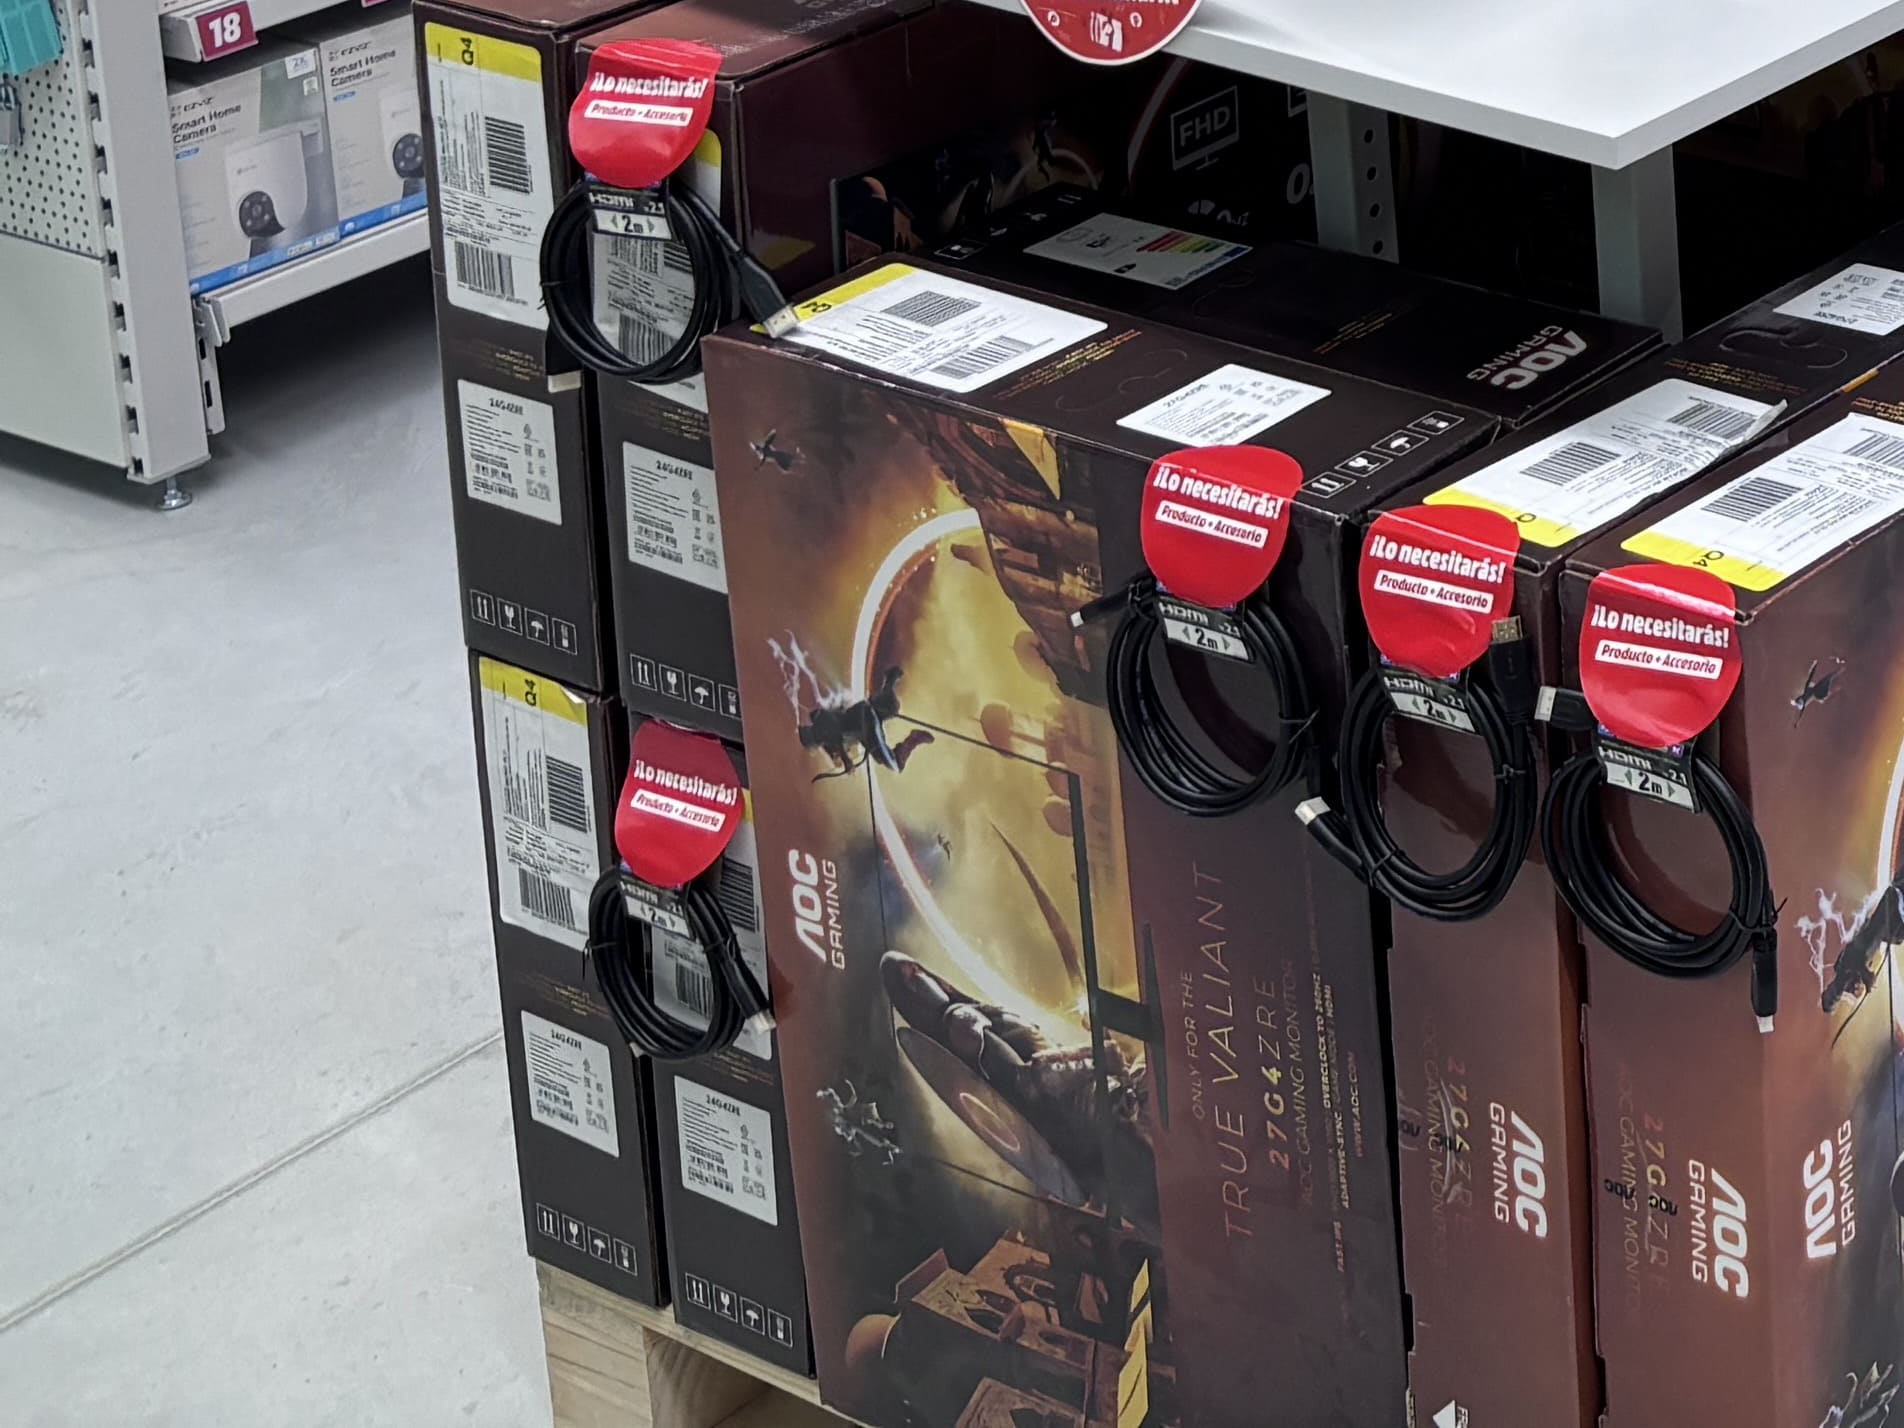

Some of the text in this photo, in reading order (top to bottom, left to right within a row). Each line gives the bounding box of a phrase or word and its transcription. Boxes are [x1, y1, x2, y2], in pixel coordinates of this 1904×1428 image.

[209, 14, 242, 45] 18
[591, 71, 708, 99] ¡Lo necesitarás!
[1176, 106, 1231, 146] FHD
[1153, 463, 1283, 521] ¡Lo necesitarás!
[1160, 504, 1264, 546] Producto Accesorio
[1371, 533, 1506, 585] ¡Lo necesitarás!
[1378, 572, 1491, 612] Producto Accesorio
[1196, 627, 1220, 651] 2m
[1590, 602, 1730, 651] ¡Lo necesitarás!
[1600, 642, 1717, 677] Producto Accesorio
[633, 759, 737, 806] ¡Lo necesitarás!
[1637, 769, 1664, 794] 2m
[788, 848, 827, 963] AOC
[830, 859, 848, 970] GAMING
[1196, 860, 1253, 1241] TRUE VALIANT
[1488, 1102, 1511, 1224] GAMING
[1510, 1111, 1548, 1239] AOC
[1838, 1119, 1854, 1247] GAMING
[1686, 1159, 1709, 1284] GAMING
[1804, 1137, 1836, 1259] AOC
[1711, 1169, 1749, 1298] AOC
